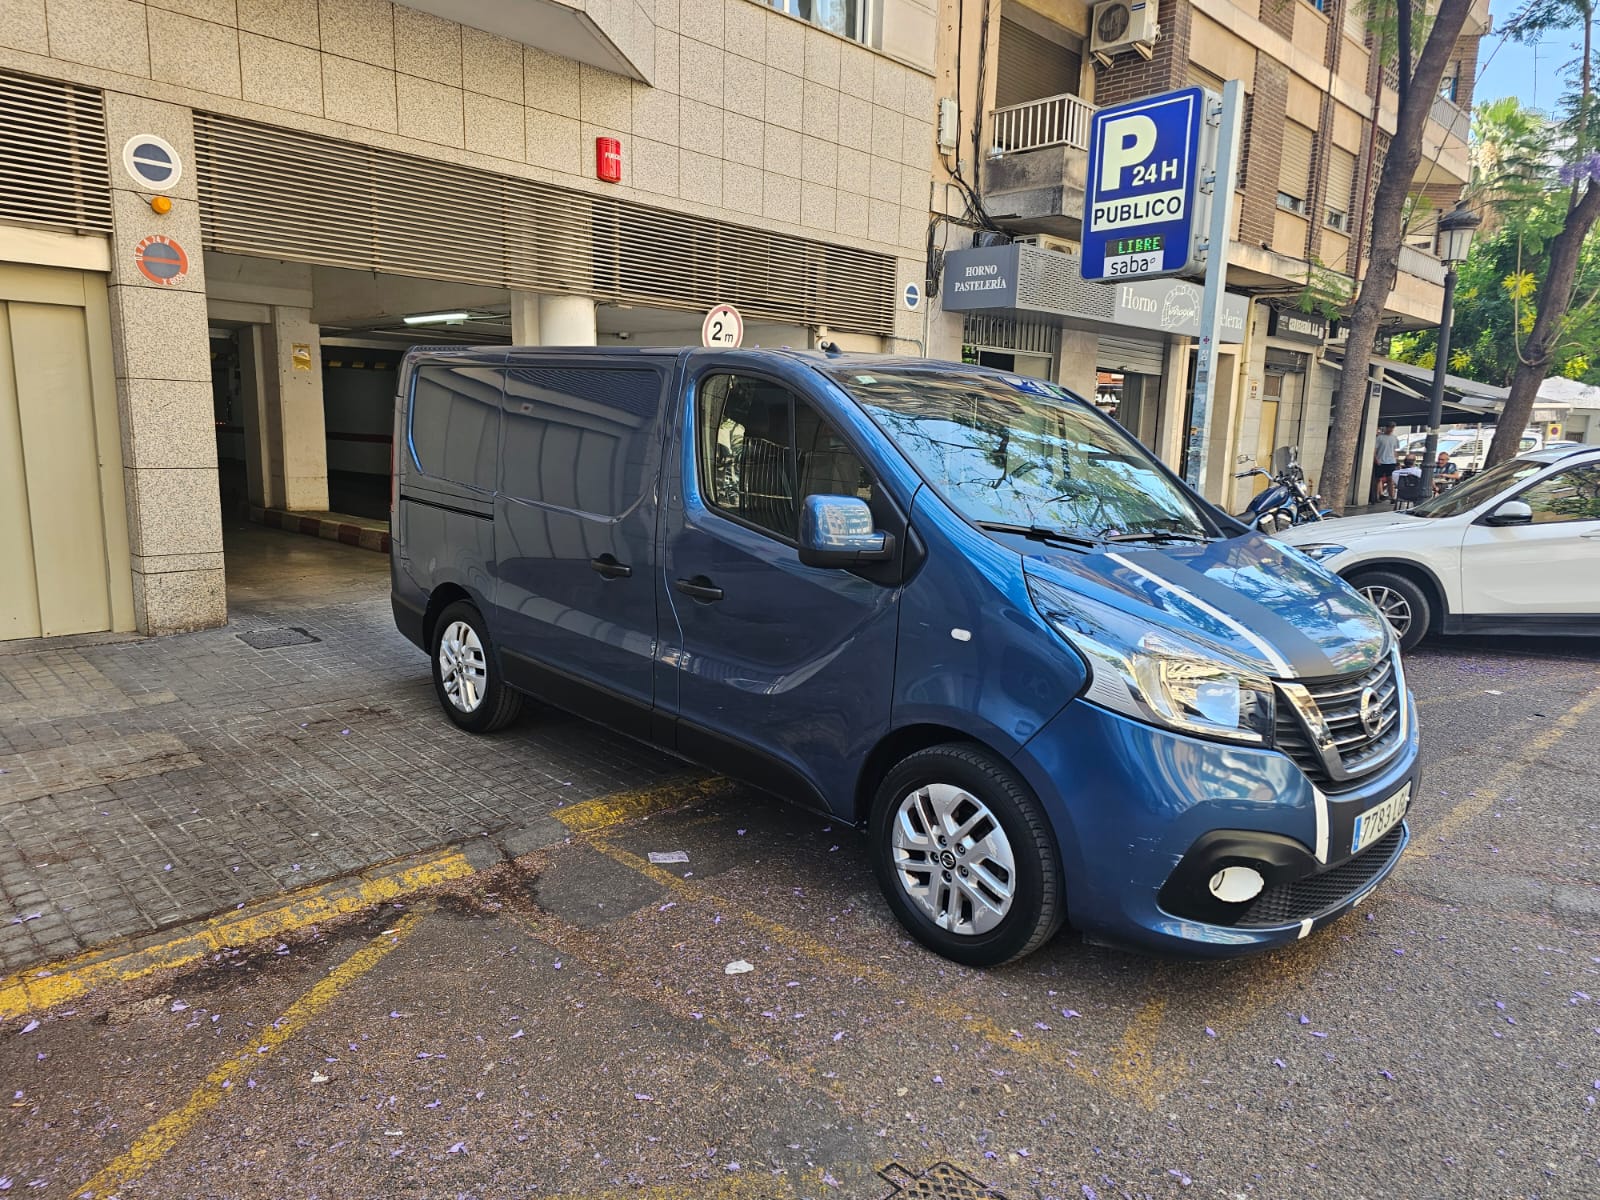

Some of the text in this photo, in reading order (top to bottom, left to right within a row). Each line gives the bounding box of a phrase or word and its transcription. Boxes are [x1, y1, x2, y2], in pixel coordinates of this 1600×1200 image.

[1101, 114, 1157, 192] P
[1093, 196, 1181, 226] PUBLICO
[1118, 236, 1161, 254] LIBRE
[965, 264, 998, 277] HORNO
[1110, 255, 1149, 275] saba
[954, 276, 1007, 292] PASTELERÍA
[1121, 286, 1158, 313] Horno
